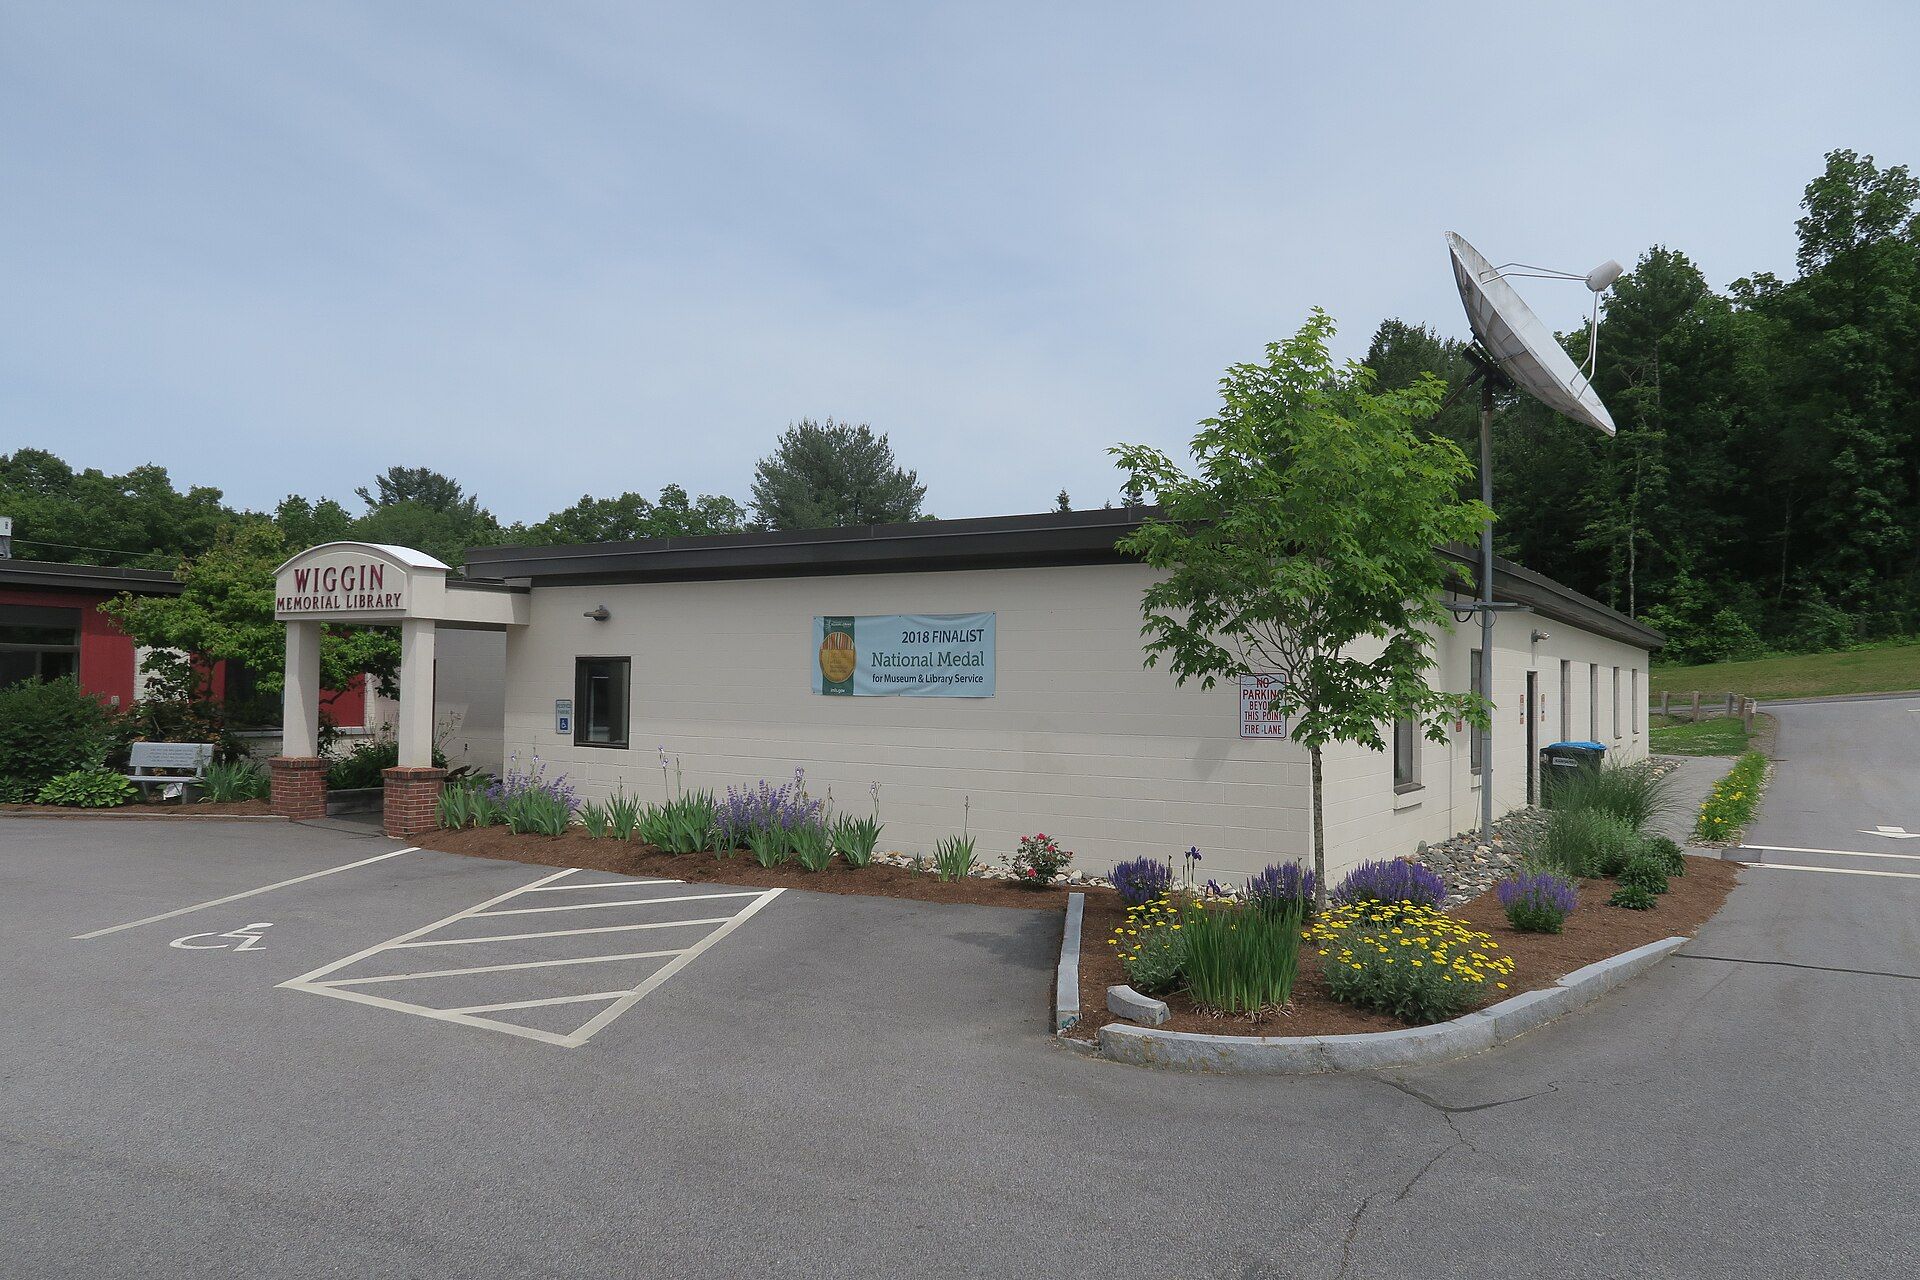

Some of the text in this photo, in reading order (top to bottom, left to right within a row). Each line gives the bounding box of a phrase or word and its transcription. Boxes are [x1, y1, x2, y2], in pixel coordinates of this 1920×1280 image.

[294, 564, 384, 593] WIGGIN
[277, 593, 402, 610] MEMORIAL LIBRARY
[901, 629, 984, 644] 2018 FINALIST
[871, 651, 985, 667] National Medal
[872, 673, 984, 685] for Museum & Library Service
[1256, 677, 1269, 688] NO
[1244, 711, 1259, 720] THIS
[1244, 724, 1281, 734] FIRE LANE
